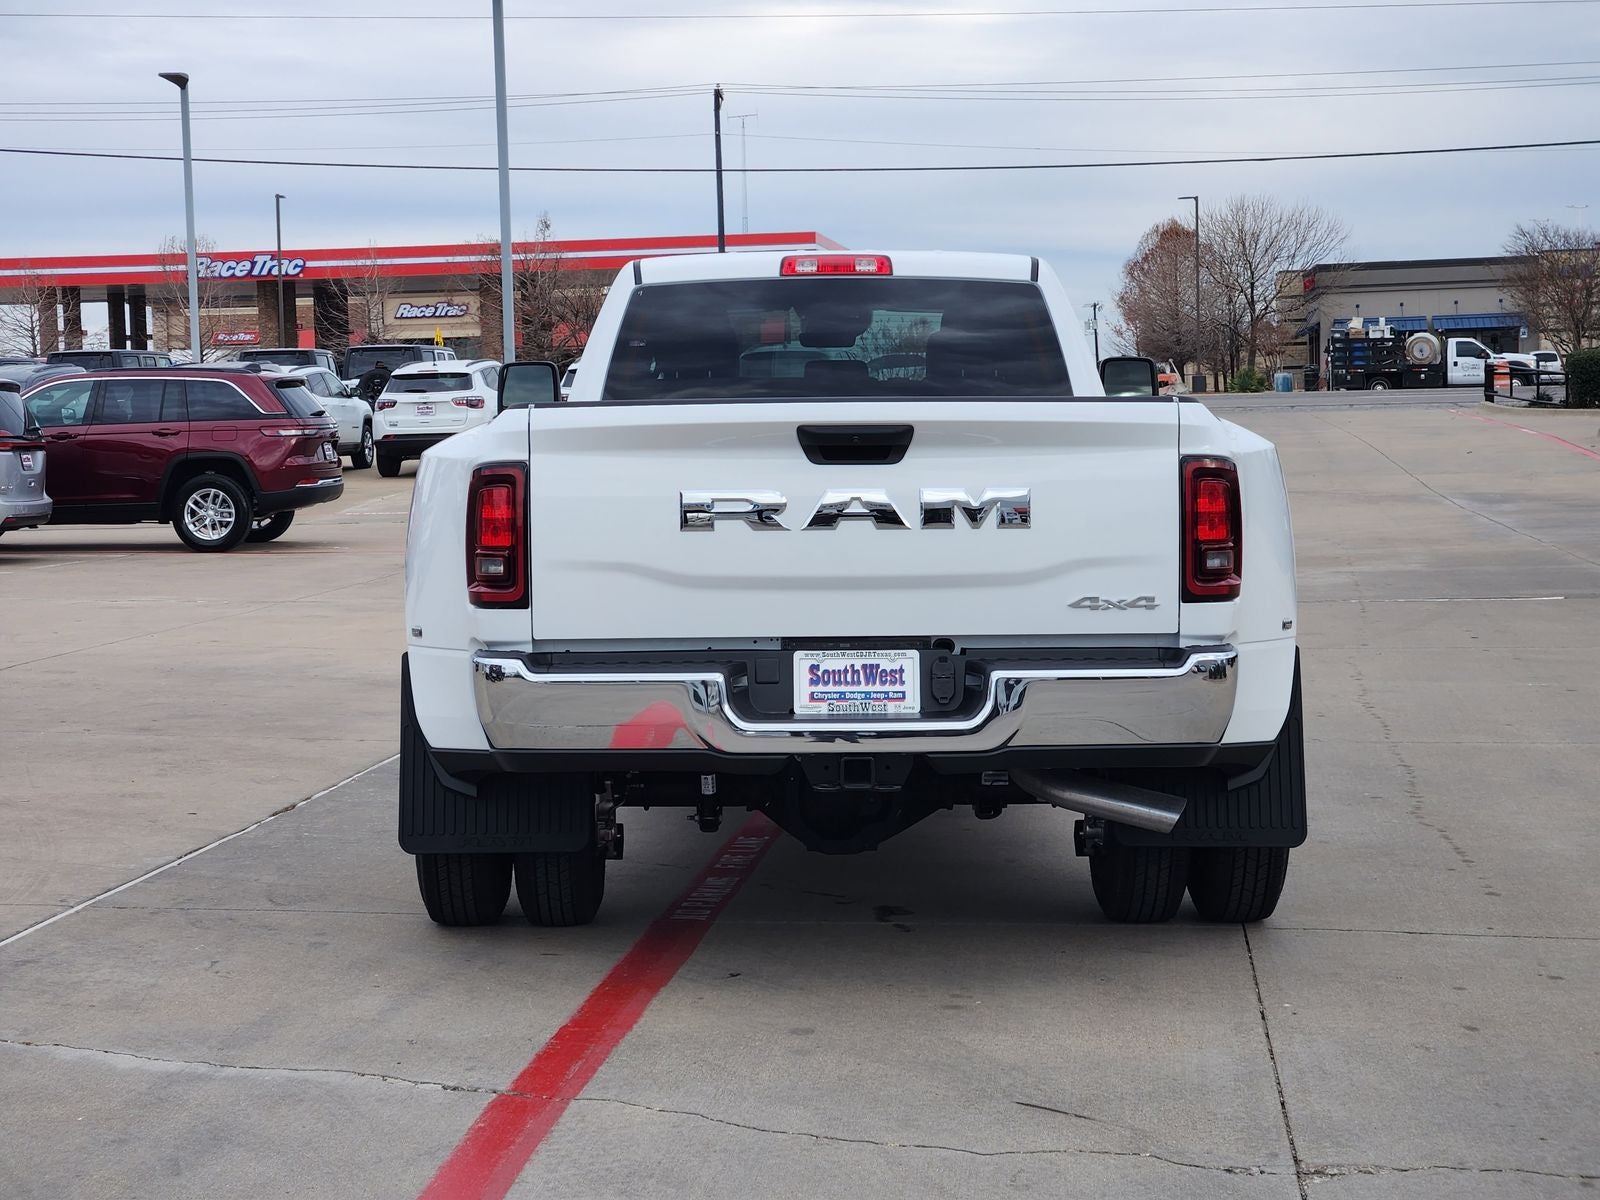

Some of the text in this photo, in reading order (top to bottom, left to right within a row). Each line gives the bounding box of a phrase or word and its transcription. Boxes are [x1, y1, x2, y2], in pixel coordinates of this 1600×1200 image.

[194, 254, 306, 278] RaceTrac
[394, 302, 469, 319] RaceTrac
[217, 332, 256, 341] RaceTrac
[680, 487, 1032, 531] RAM
[1067, 595, 1161, 611] 4x4
[808, 663, 906, 688] SouthWest
[814, 692, 840, 700] Chrysler
[870, 692, 885, 700] Jeep
[888, 691, 903, 699] Ram
[827, 702, 889, 713] SouthWest
